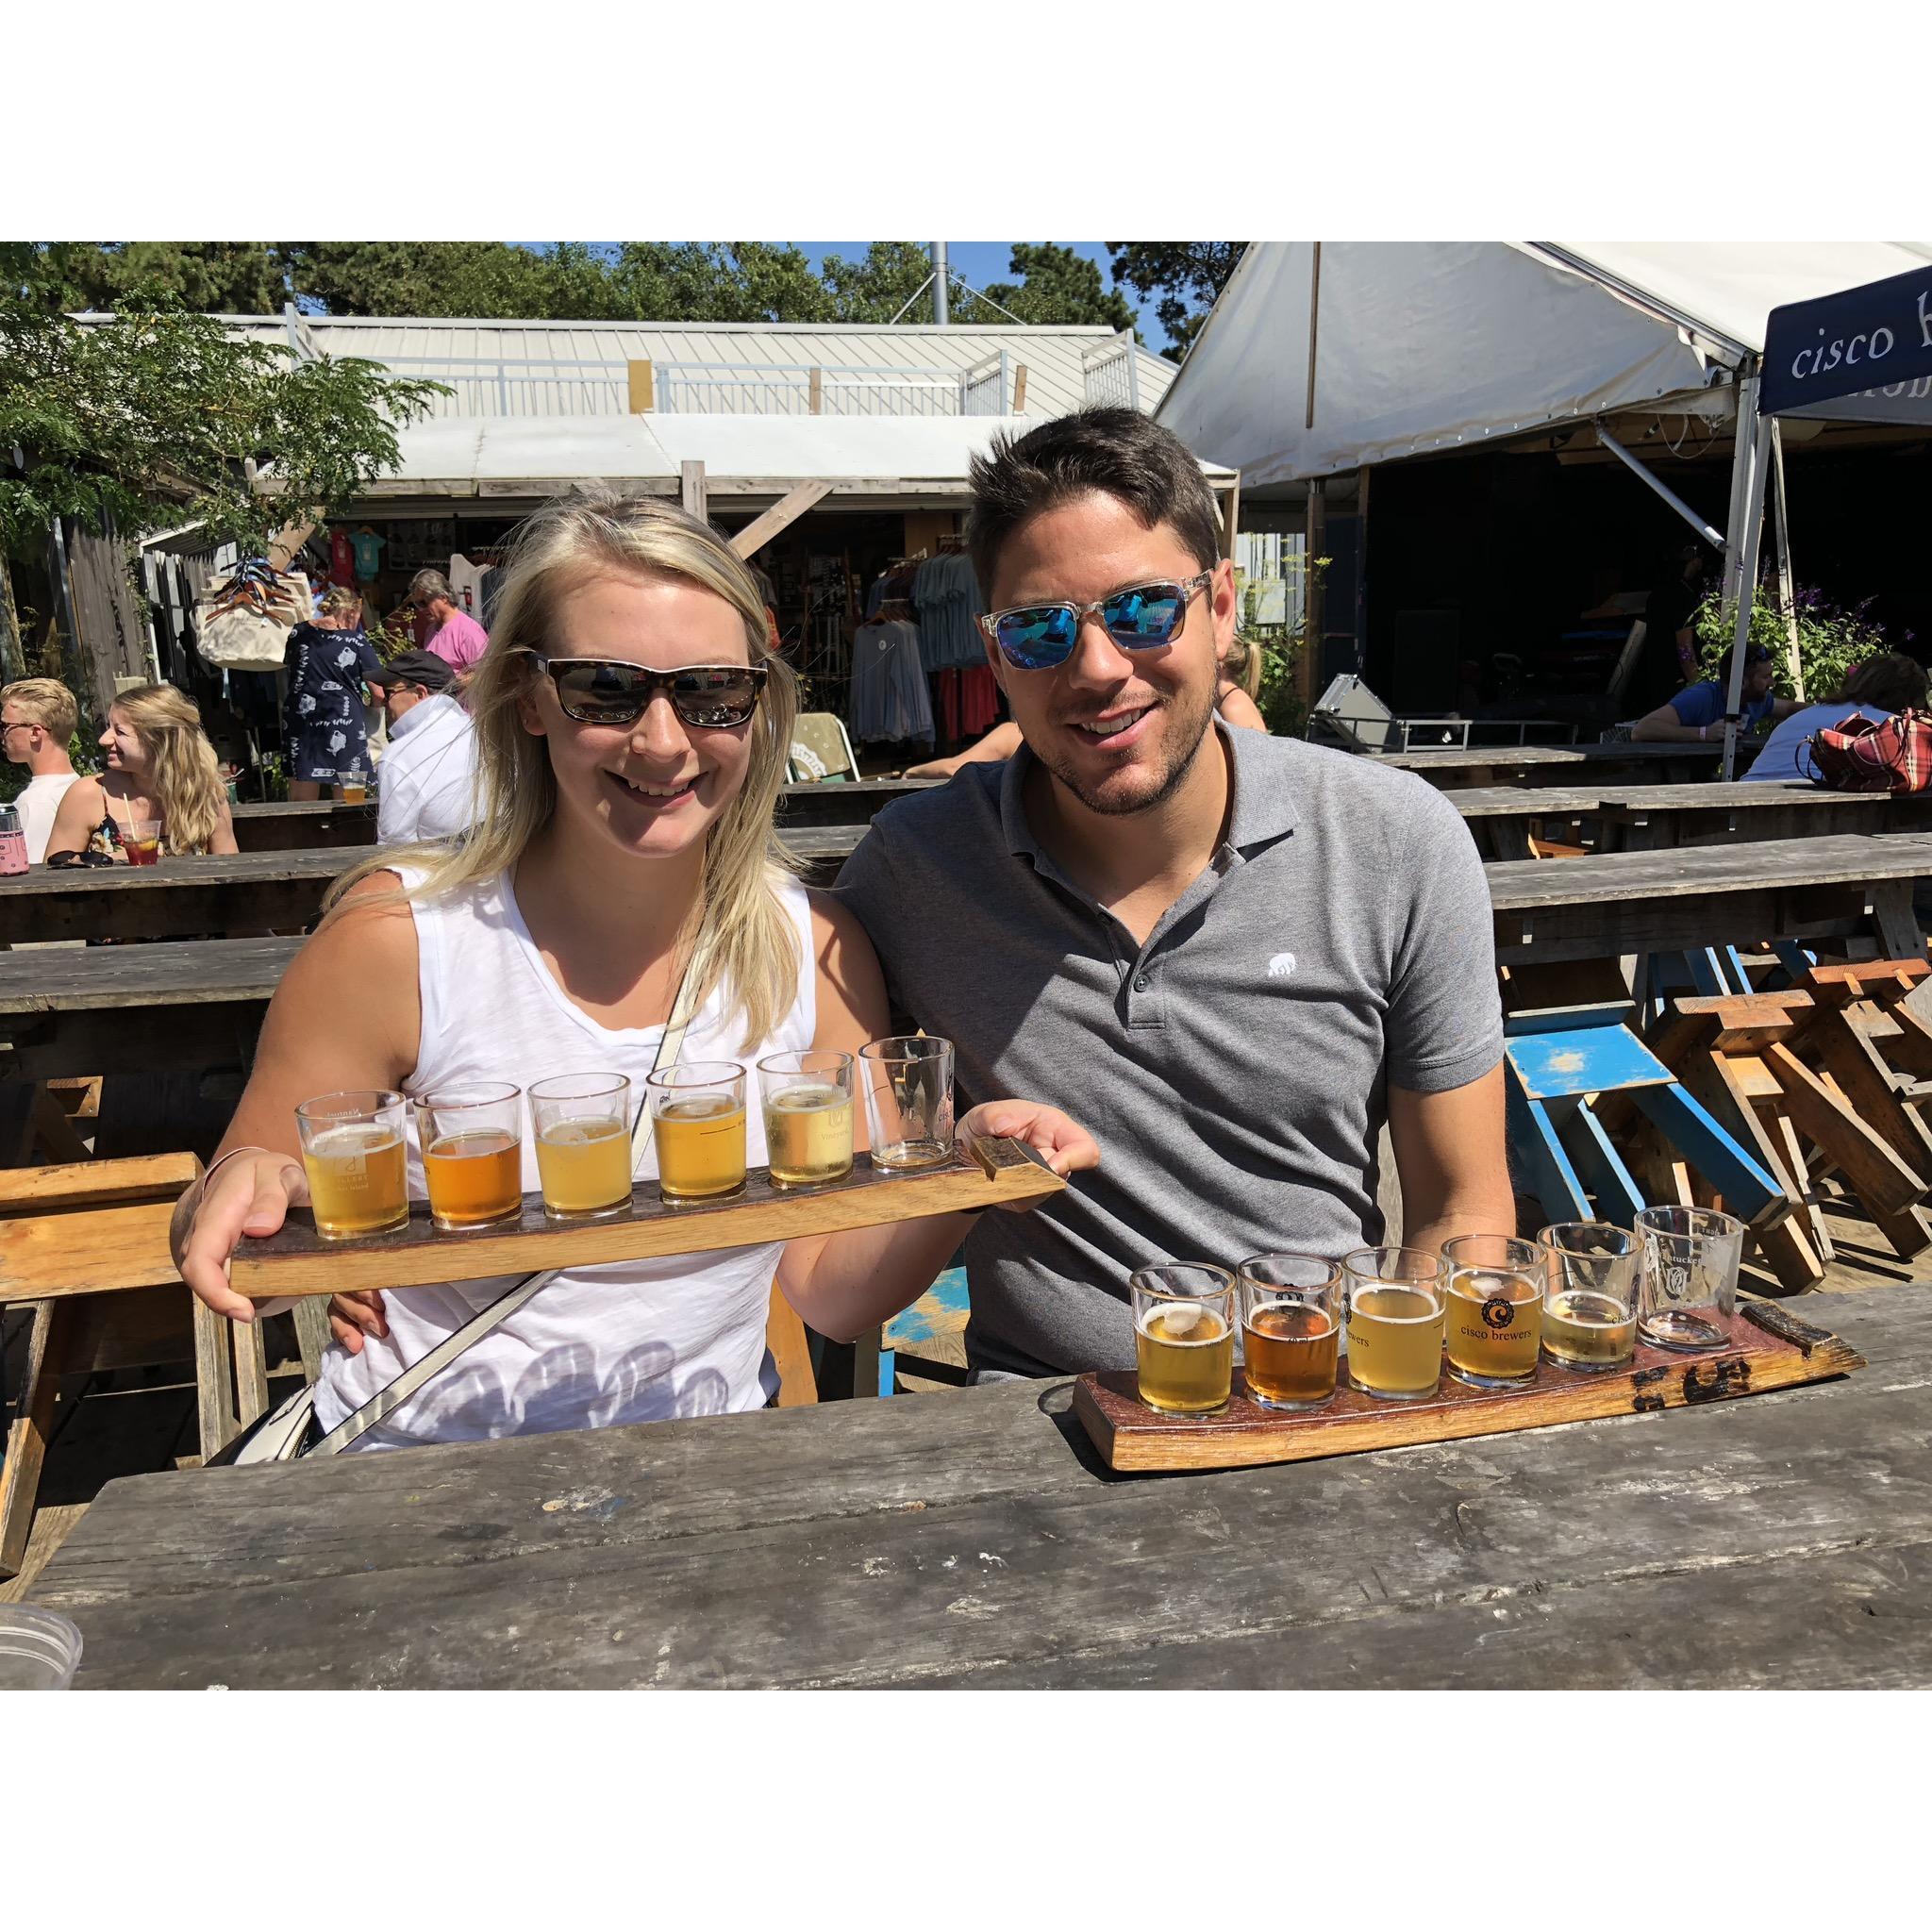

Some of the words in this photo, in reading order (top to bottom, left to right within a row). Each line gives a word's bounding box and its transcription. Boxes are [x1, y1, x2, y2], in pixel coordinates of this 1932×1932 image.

[1791, 327, 1894, 379] cisco
[1347, 1331, 1370, 1347] ewers
[1460, 1324, 1489, 1340] cisco
[1491, 1329, 1532, 1341] brewers
